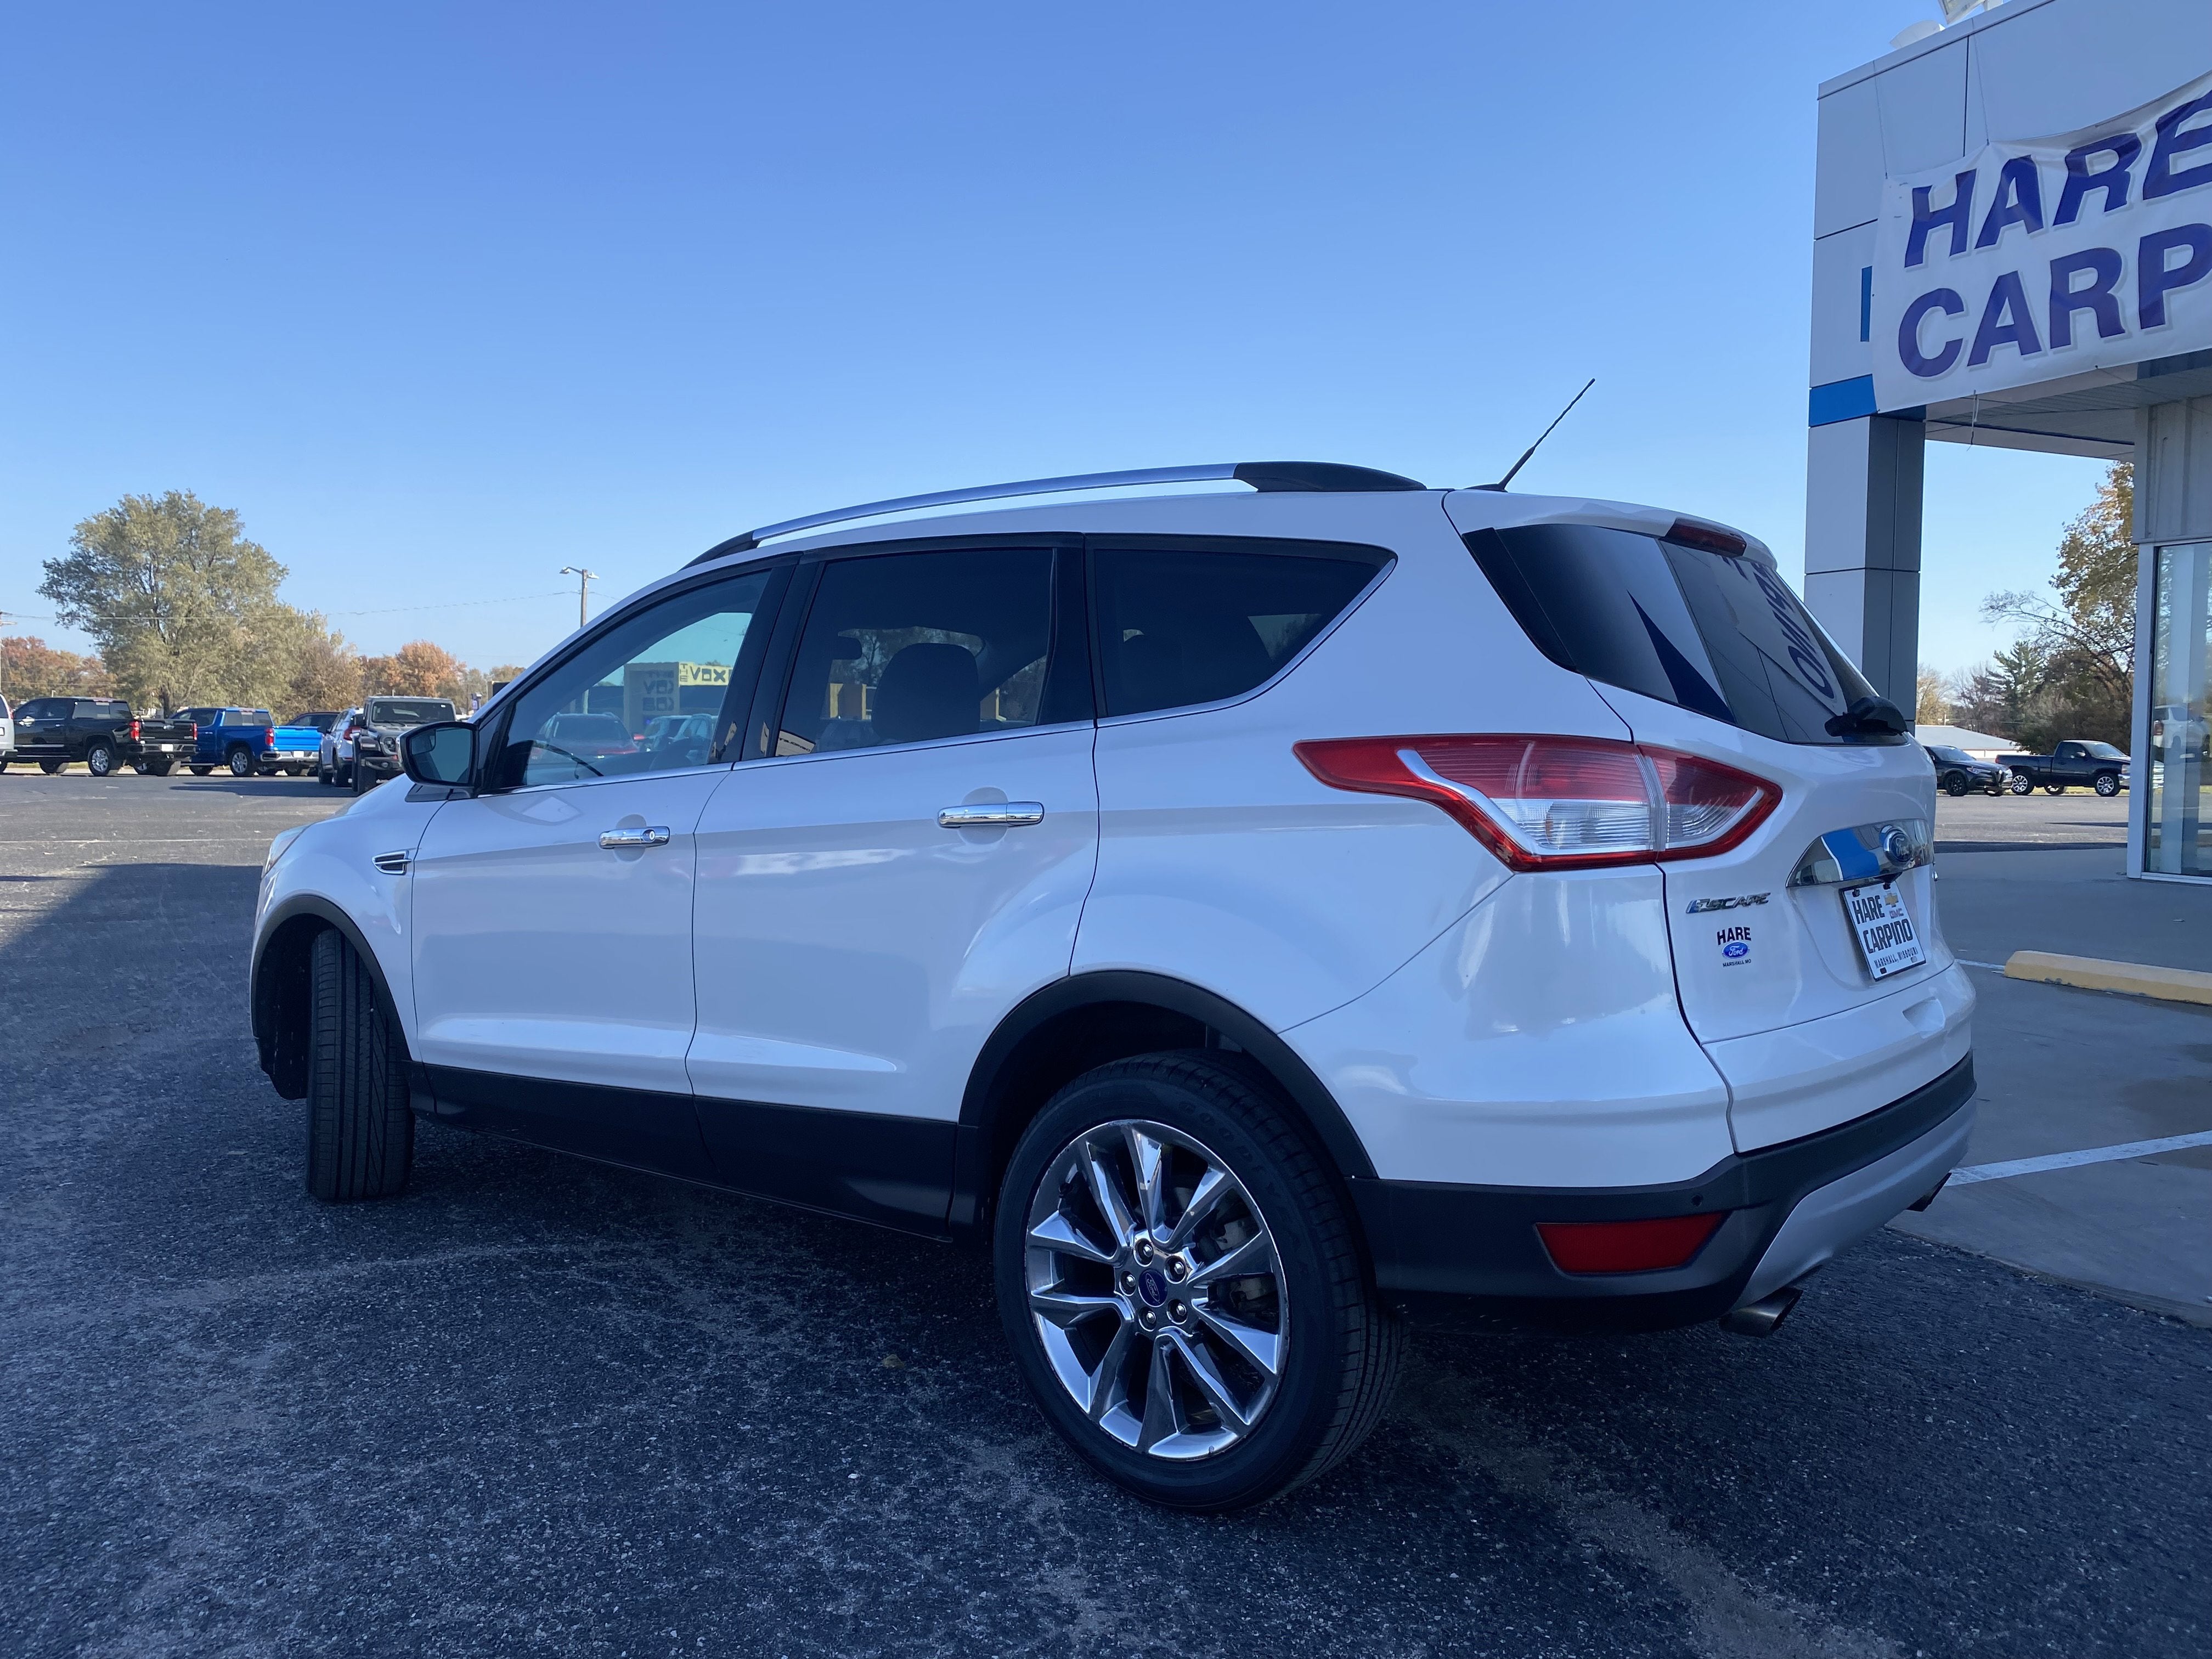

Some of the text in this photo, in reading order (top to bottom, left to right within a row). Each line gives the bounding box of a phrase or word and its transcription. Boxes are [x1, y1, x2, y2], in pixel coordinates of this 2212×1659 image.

[1904, 89, 2212, 268] HARE
[680, 663, 688, 682] THE
[690, 665, 726, 682] VOX
[1686, 892, 1771, 913] ESCAPE
[1852, 895, 1886, 924] HARE
[1717, 926, 1752, 945] HARE
[1863, 918, 1914, 954] CARPINO
[1898, 946, 1918, 961] MISSOURI
